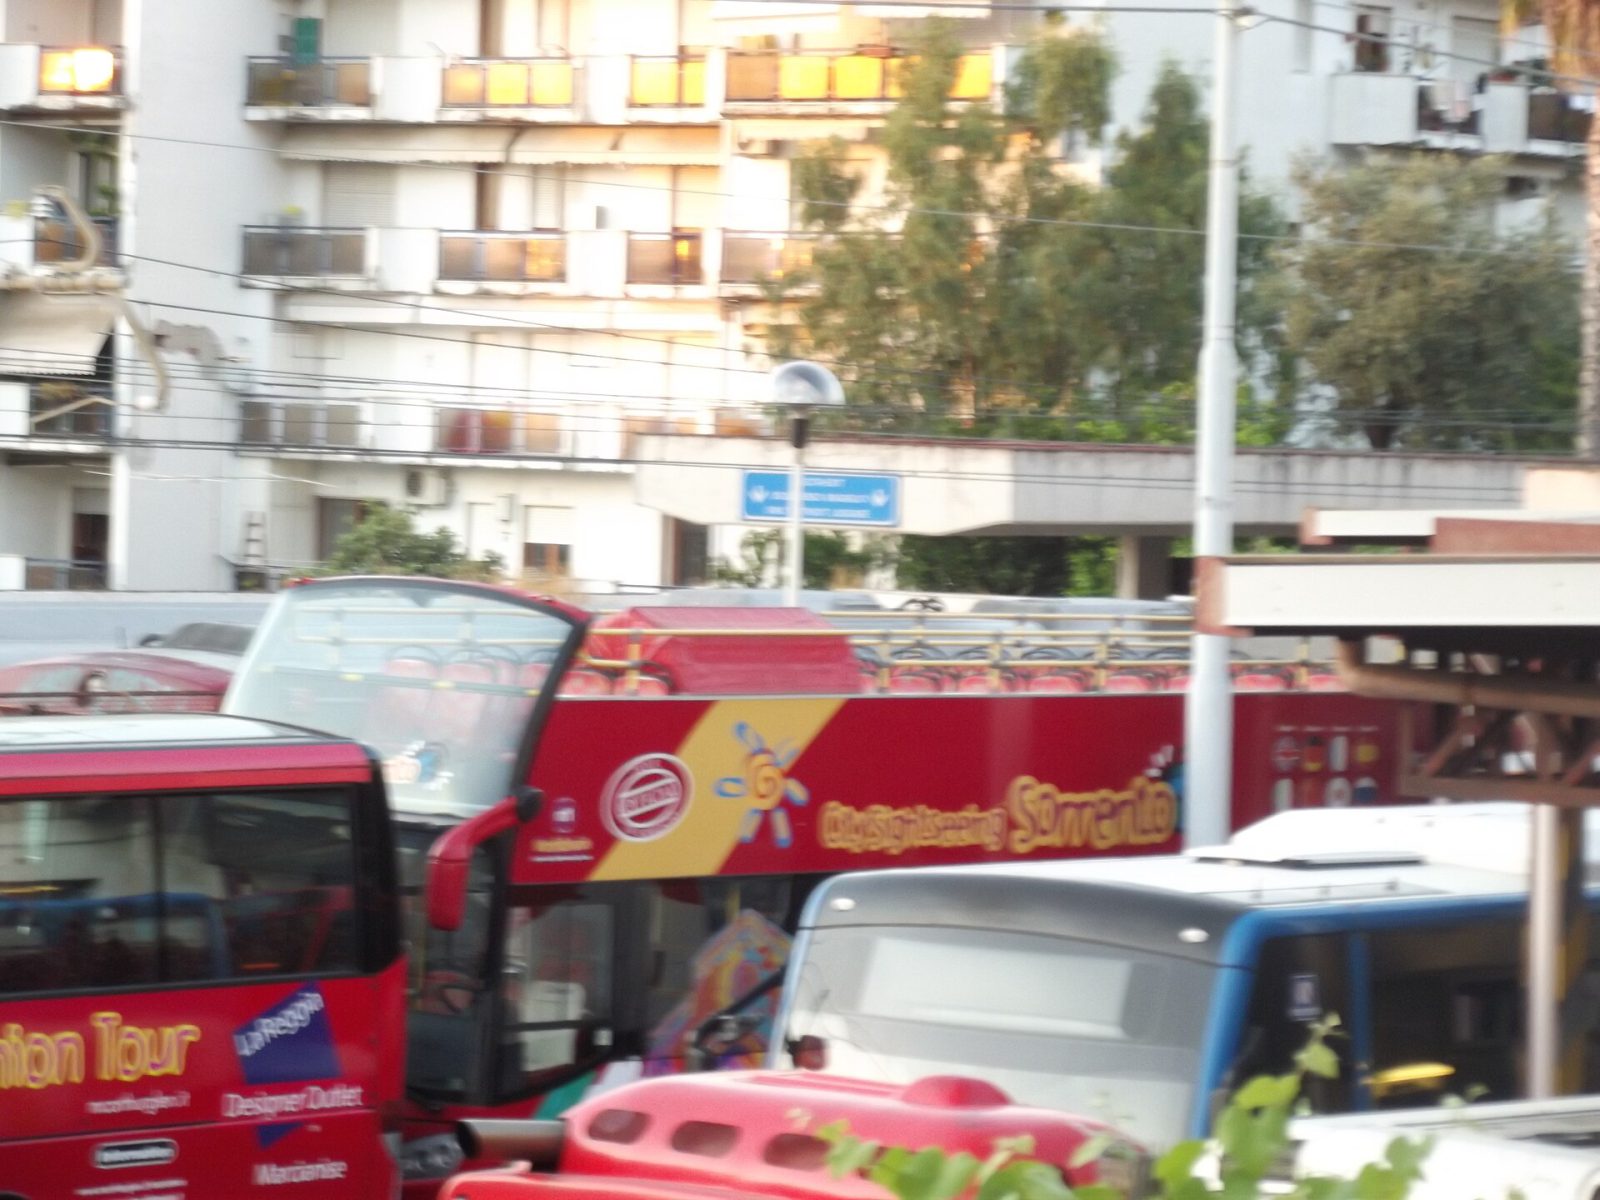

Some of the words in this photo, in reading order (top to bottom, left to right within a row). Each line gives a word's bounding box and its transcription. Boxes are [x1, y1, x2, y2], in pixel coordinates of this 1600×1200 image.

[1007, 775, 1176, 853] Sorrento
[90, 1012, 200, 1082] Tour
[222, 1092, 307, 1120] Designer
[304, 1084, 363, 1110] Outlet
